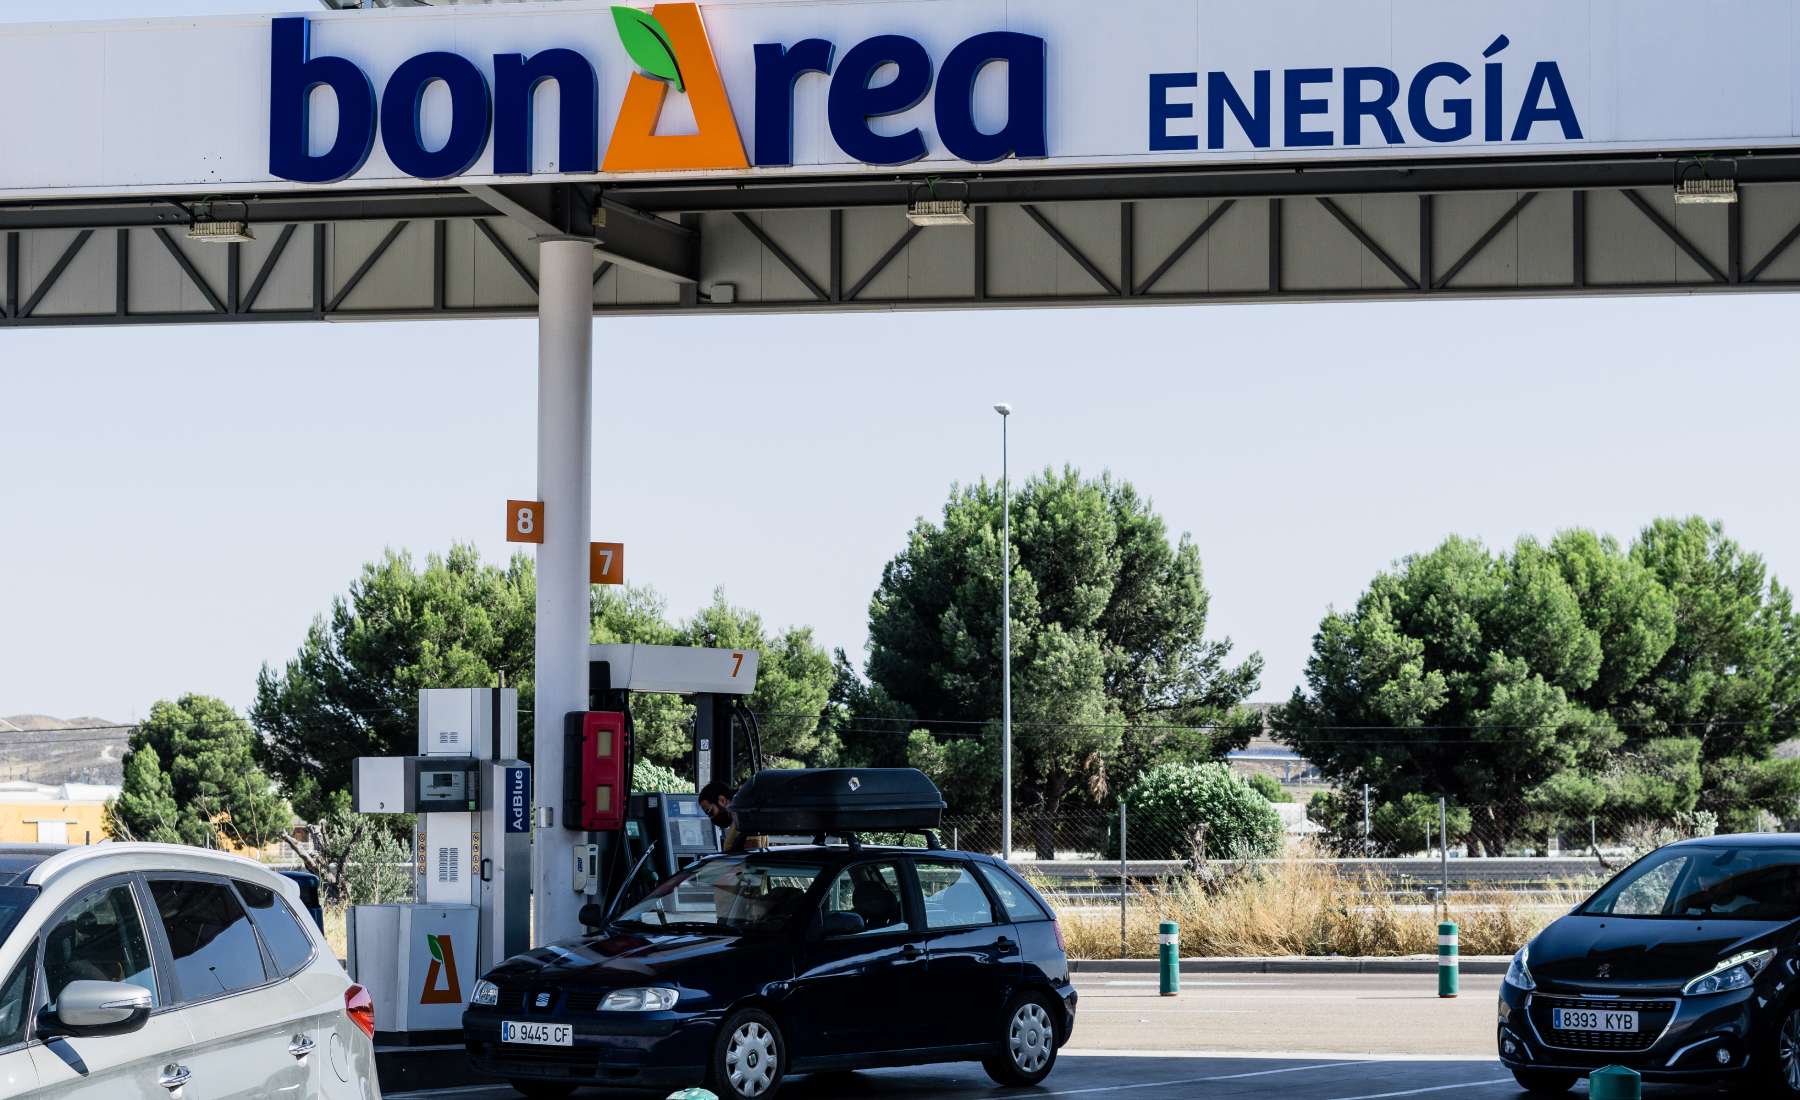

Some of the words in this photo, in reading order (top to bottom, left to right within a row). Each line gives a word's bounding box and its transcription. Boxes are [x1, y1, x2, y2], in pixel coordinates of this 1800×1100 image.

[1149, 34, 1584, 151] ENERGÍA
[517, 507, 534, 534] 8
[599, 549, 613, 576] 7
[732, 652, 744, 678] 7
[512, 769, 523, 831] AdBlue
[520, 1025, 549, 1042] 9445
[554, 1026, 570, 1043] CF
[1563, 1012, 1597, 1028] 8393
[1605, 1013, 1633, 1030] KYB
